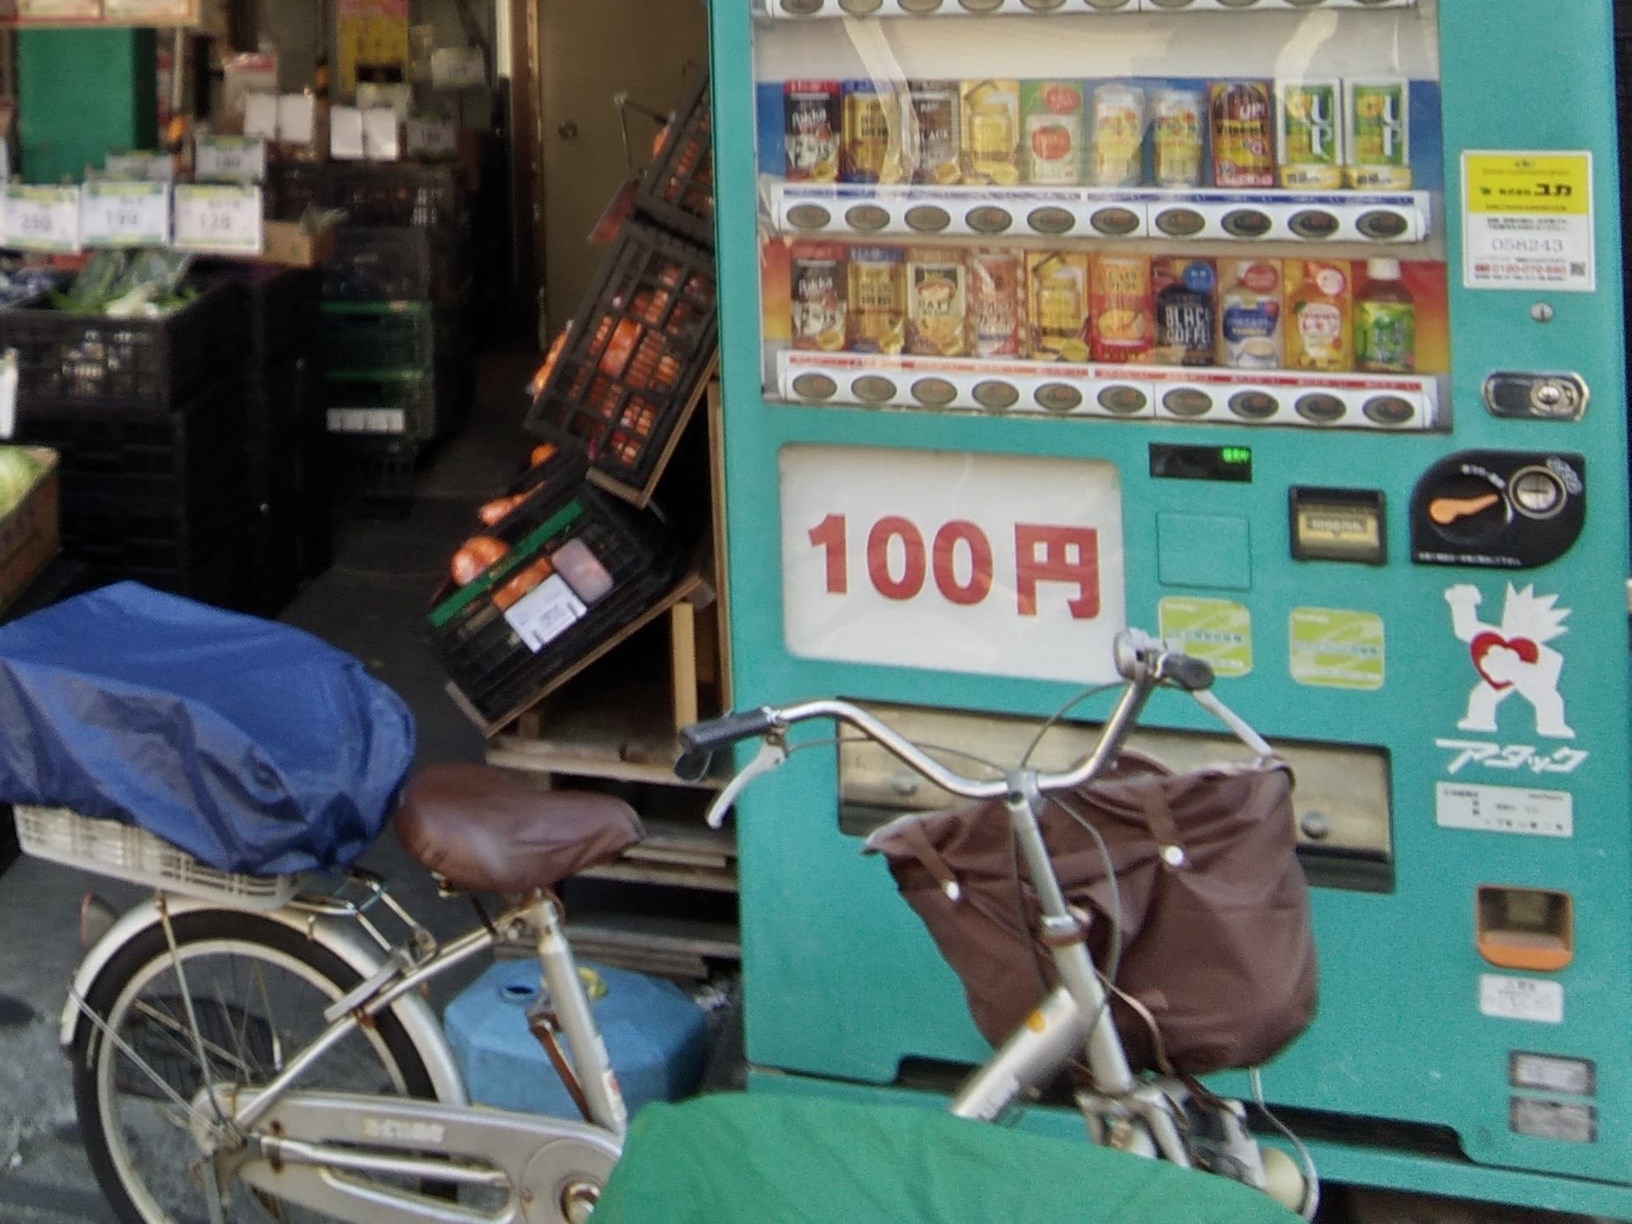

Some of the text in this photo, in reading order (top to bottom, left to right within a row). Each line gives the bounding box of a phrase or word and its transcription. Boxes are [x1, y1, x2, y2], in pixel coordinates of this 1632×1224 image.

[806, 512, 1102, 621] 100円
[1434, 737, 1590, 775] アタック
